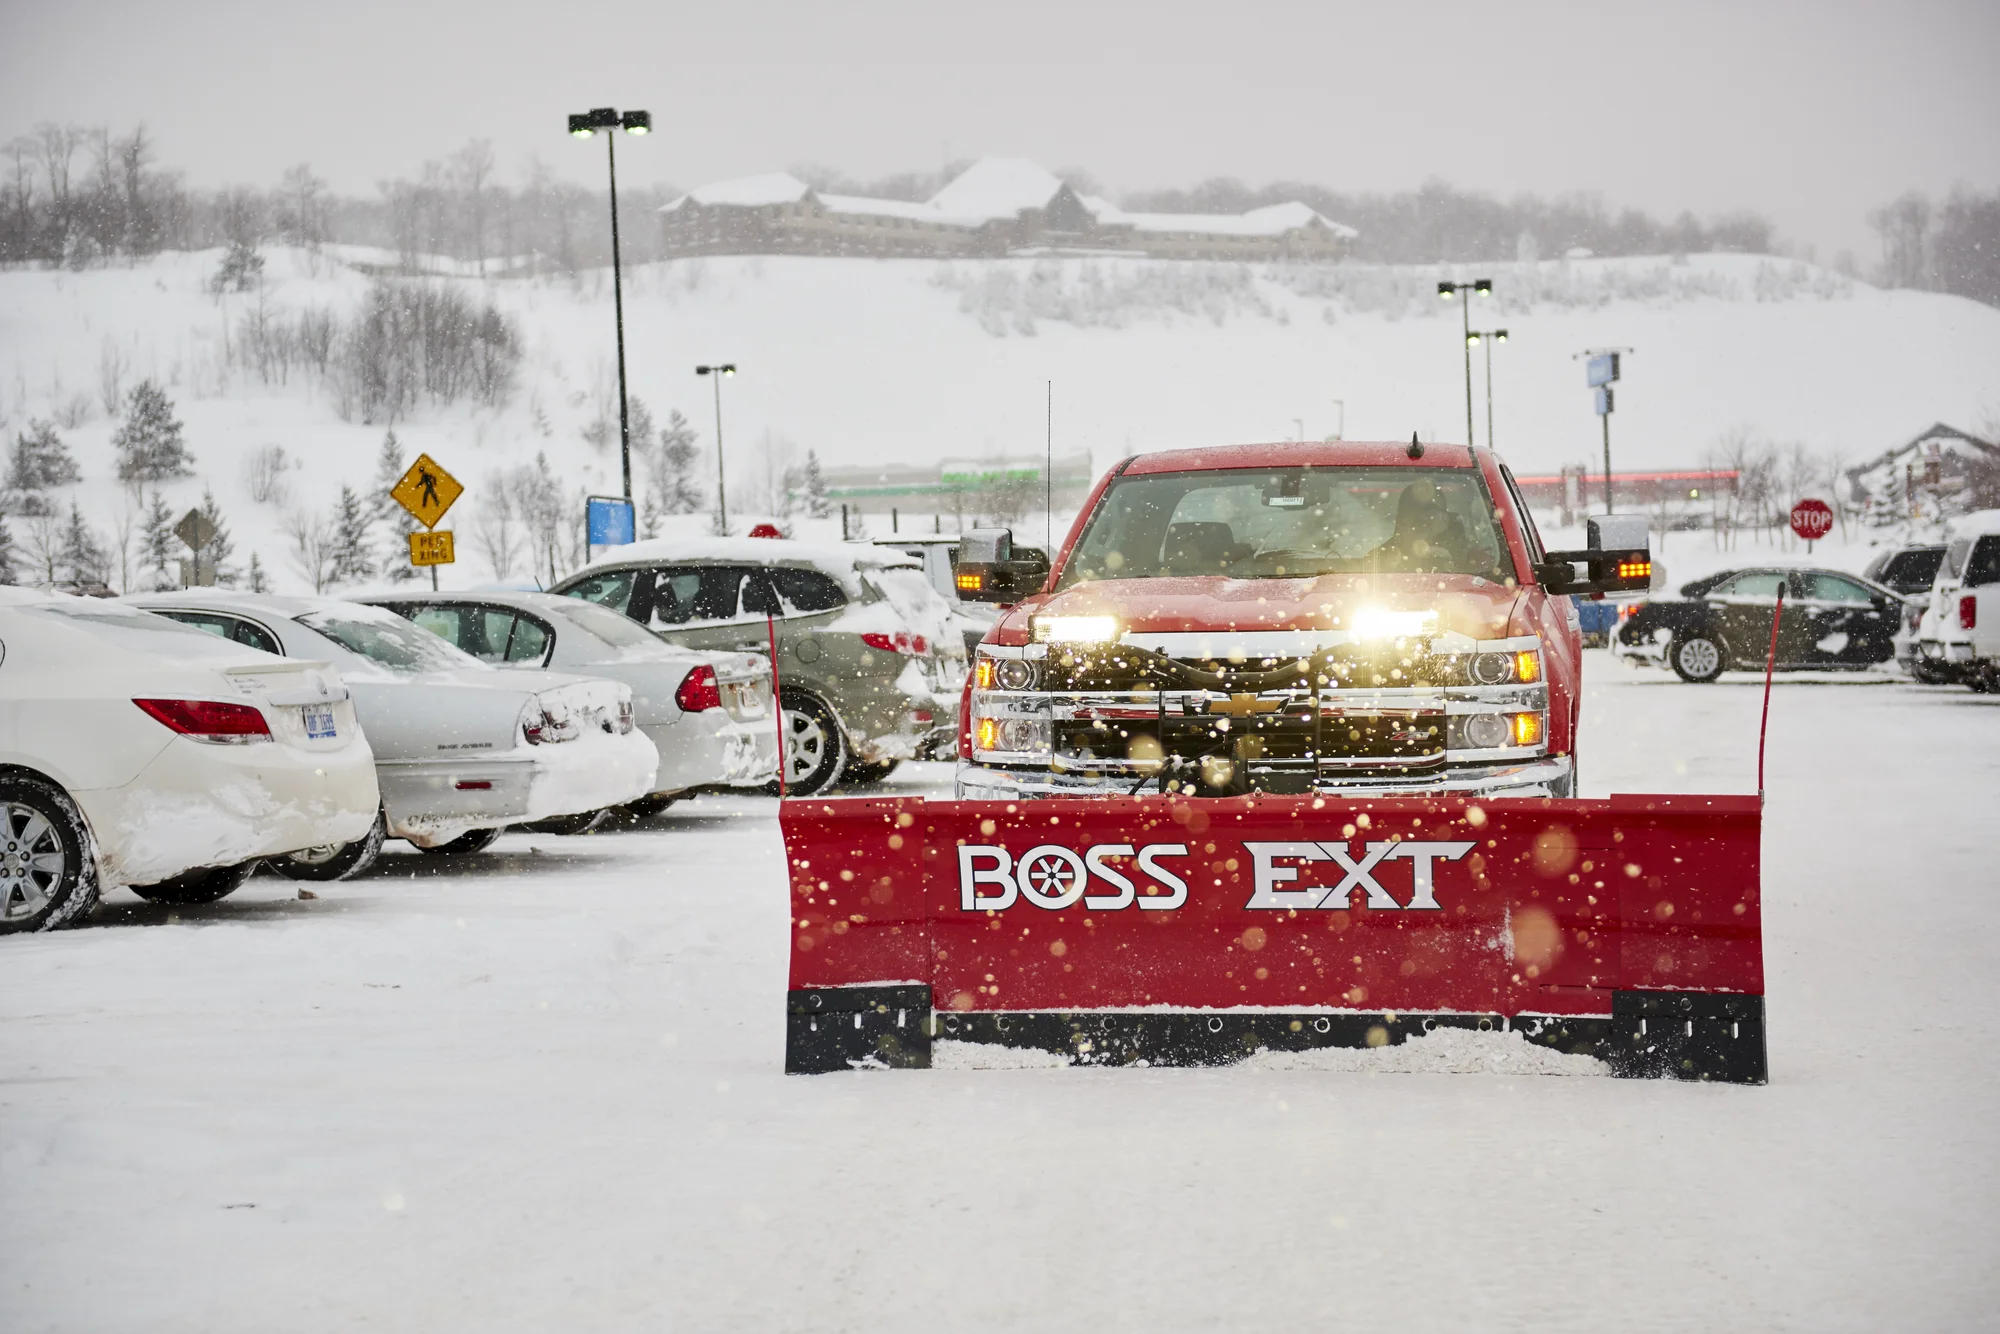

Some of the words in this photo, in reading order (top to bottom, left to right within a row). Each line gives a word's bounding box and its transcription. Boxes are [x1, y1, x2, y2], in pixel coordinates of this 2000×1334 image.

[1792, 510, 1831, 528] STOP
[420, 548, 447, 560] XING
[957, 844, 1189, 911] BOSS
[1242, 840, 1478, 910] EXT
